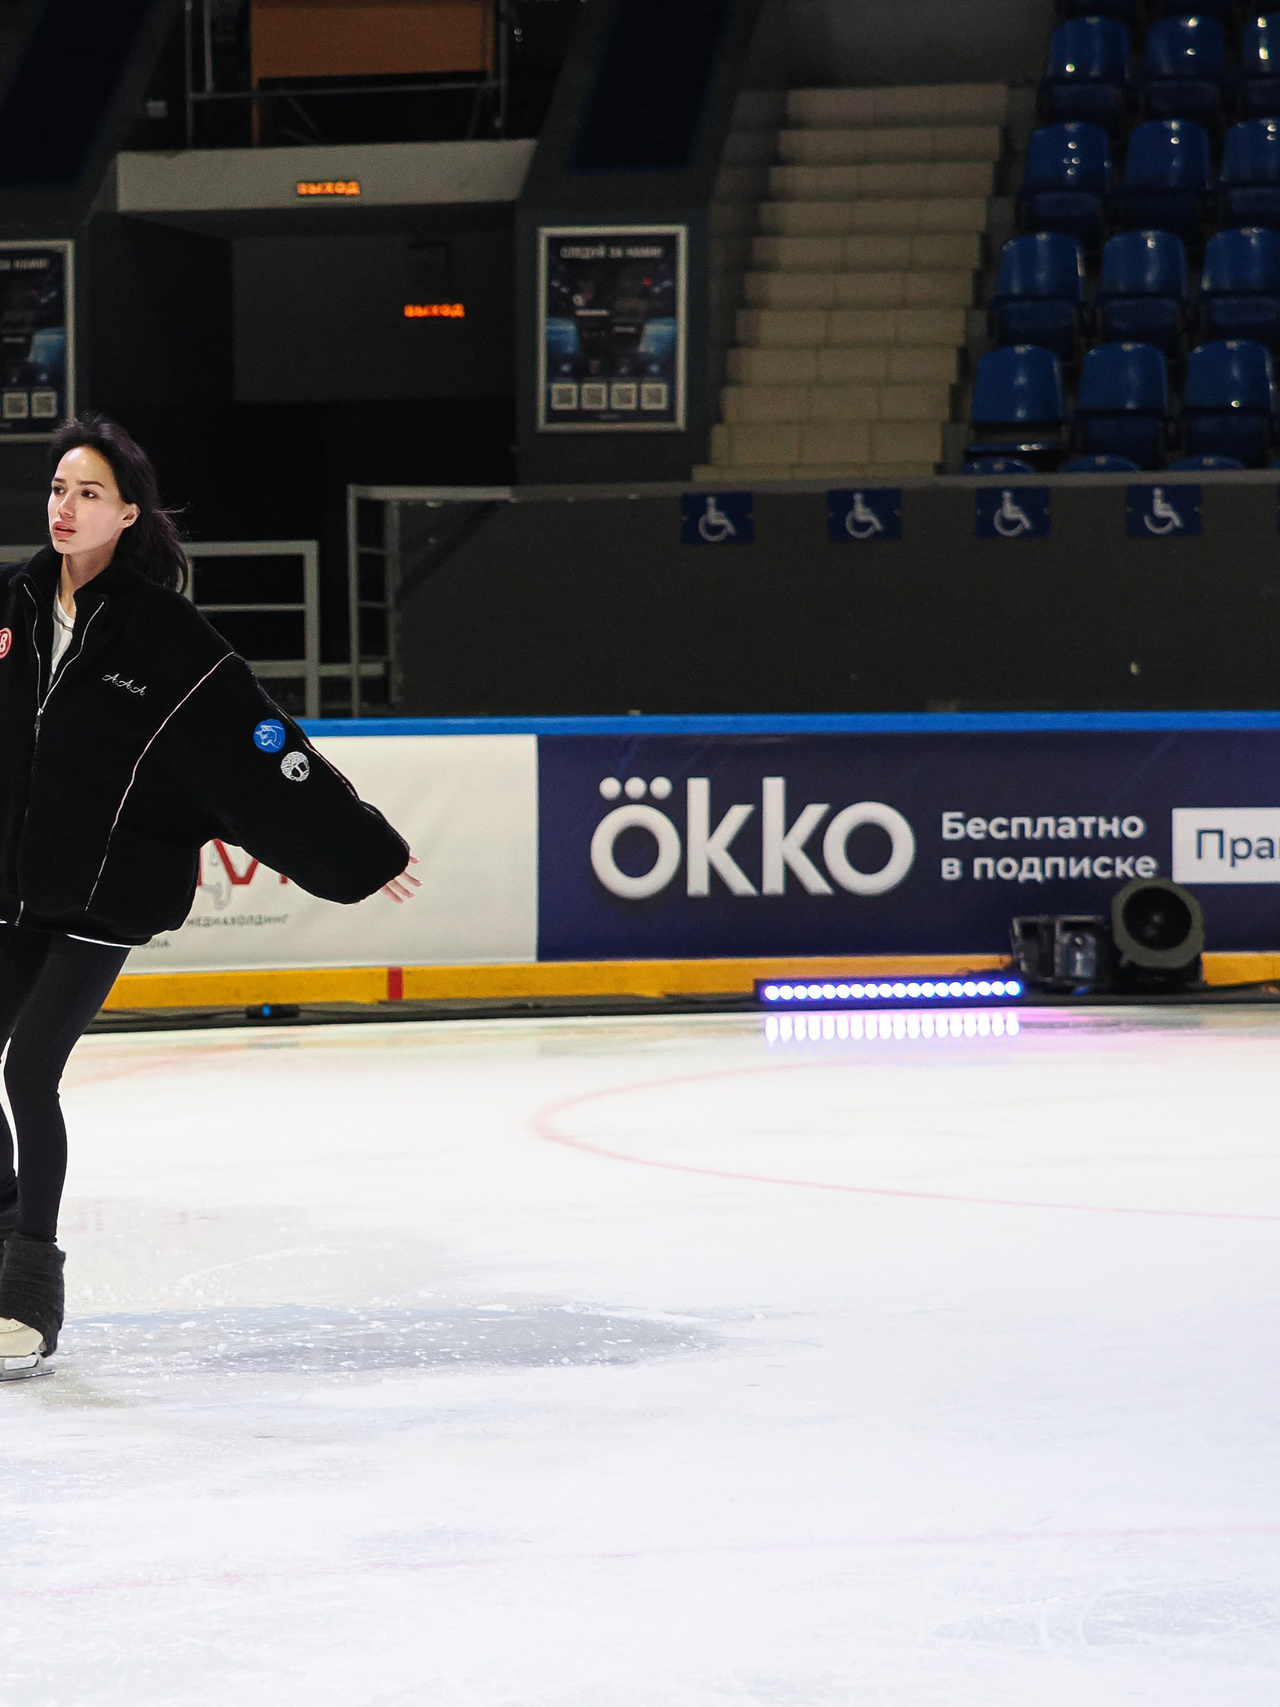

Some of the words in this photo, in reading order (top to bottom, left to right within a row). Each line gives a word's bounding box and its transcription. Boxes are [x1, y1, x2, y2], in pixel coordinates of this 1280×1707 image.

[941, 811, 1145, 840] Бесплатно
[1196, 829, 1280, 868] Пра
[941, 857, 961, 880] в
[973, 855, 1158, 883] подписке
